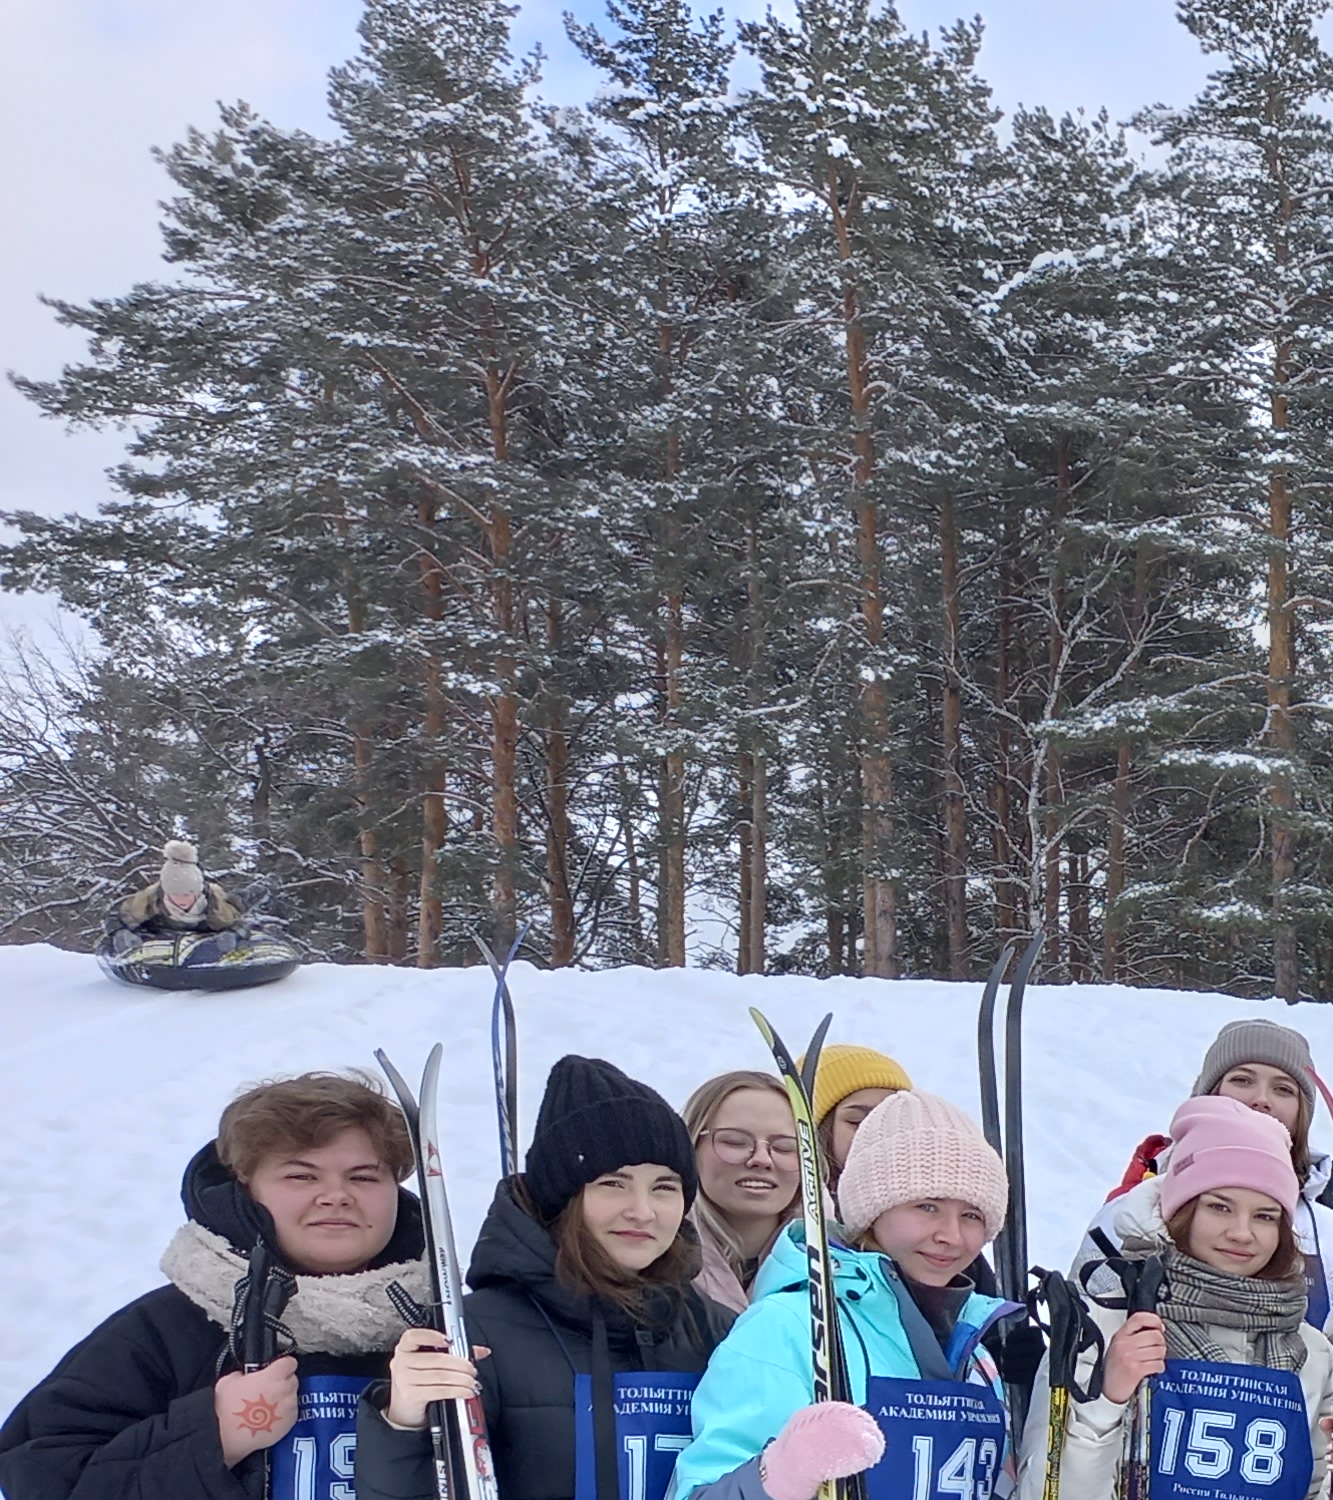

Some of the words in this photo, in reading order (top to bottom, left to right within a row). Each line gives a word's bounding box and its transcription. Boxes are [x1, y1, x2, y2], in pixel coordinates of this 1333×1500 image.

[798, 1116, 819, 1226] ACTIVE
[808, 1244, 830, 1404] arsen
[1157, 1380, 1227, 1399] АКАДЕМИЯ
[1180, 1369, 1288, 1396] ТОЛЬЯТТИНСКАЯ
[878, 1406, 956, 1421] АКАДЕМИЯ
[1158, 1407, 1287, 1485] 158
[1173, 1482, 1210, 1497] Россия
